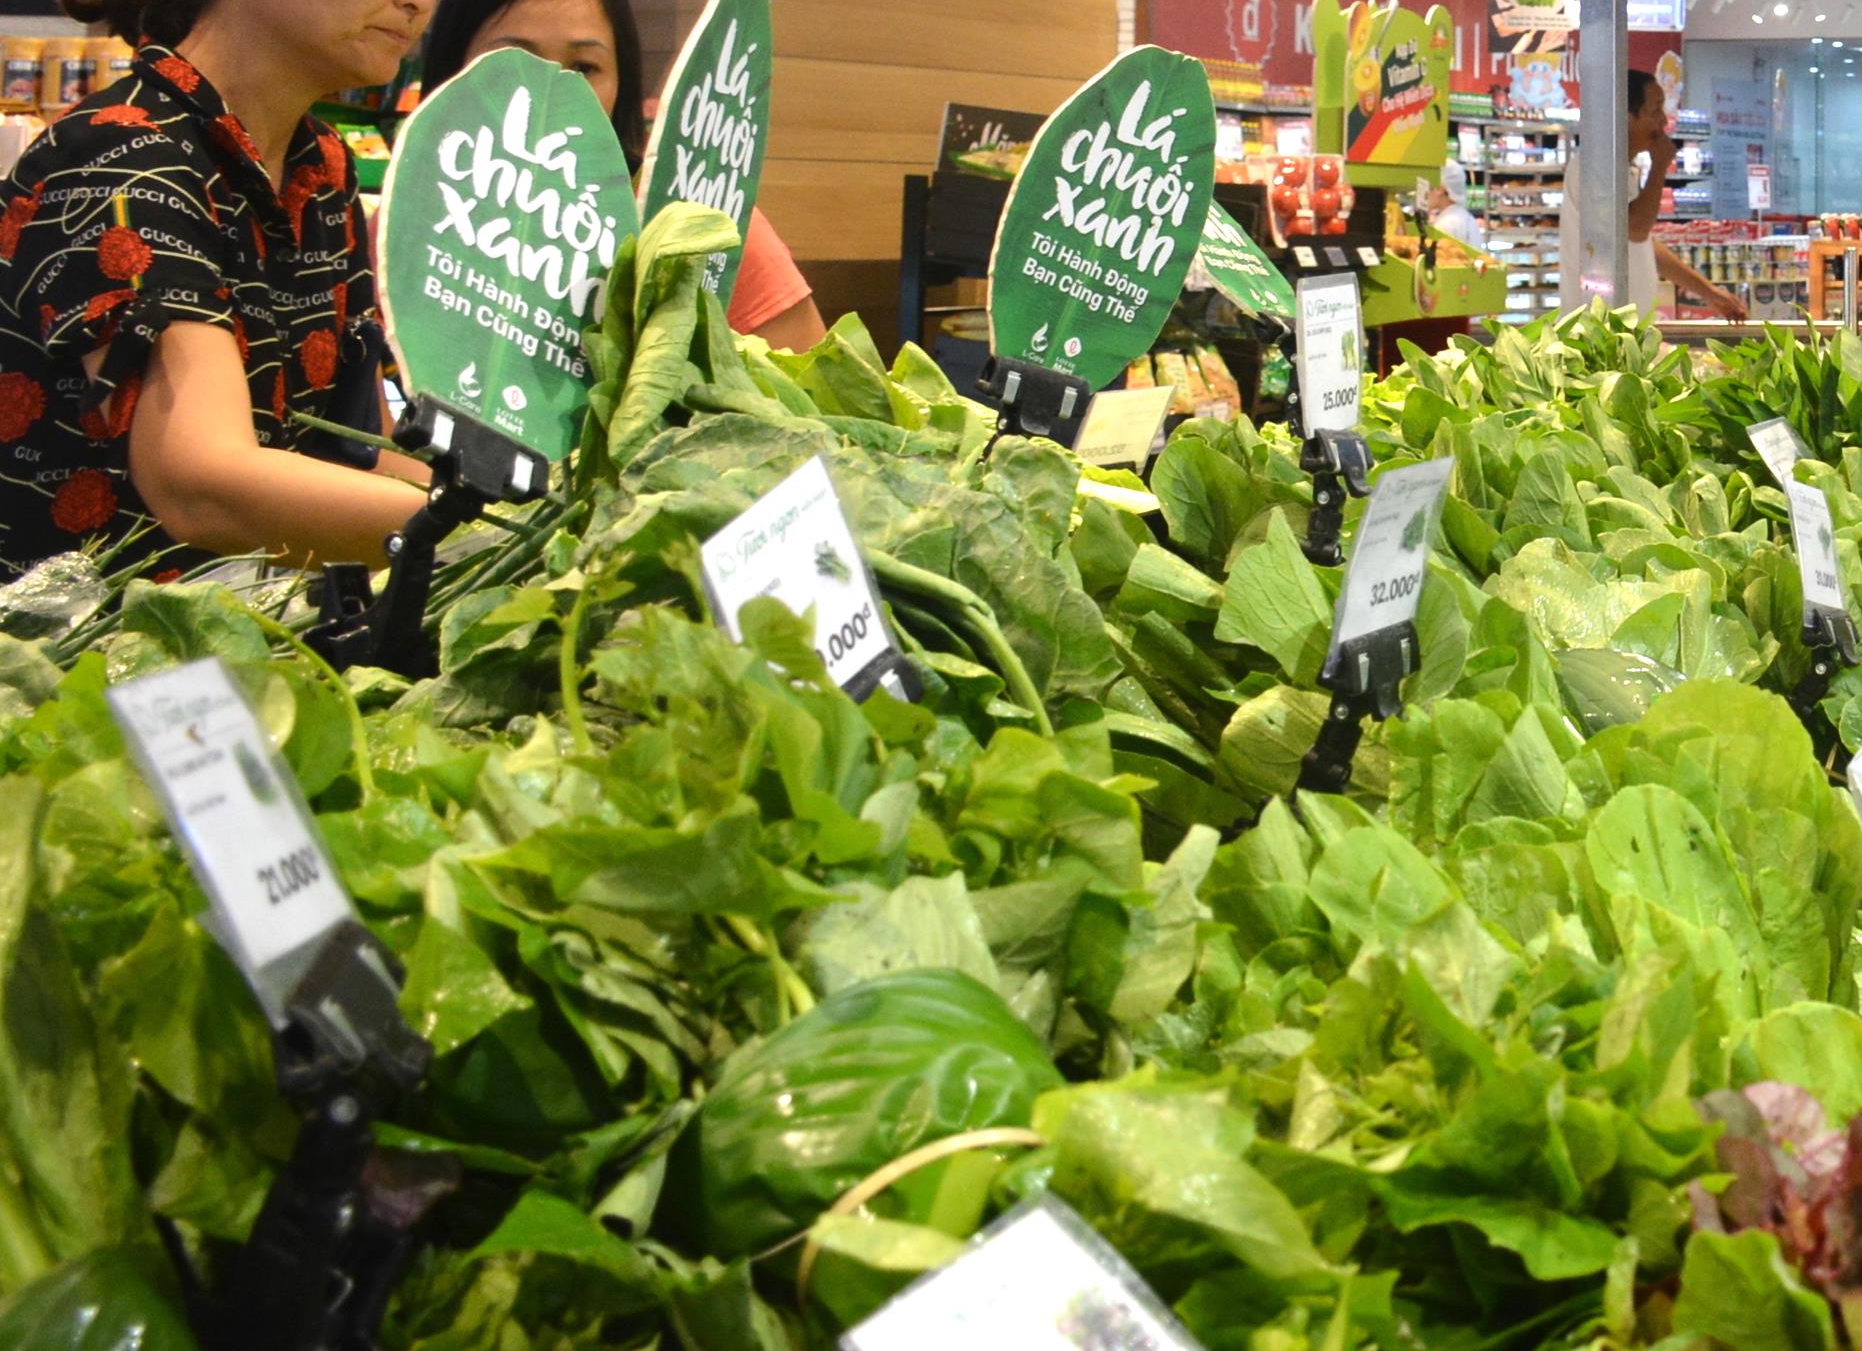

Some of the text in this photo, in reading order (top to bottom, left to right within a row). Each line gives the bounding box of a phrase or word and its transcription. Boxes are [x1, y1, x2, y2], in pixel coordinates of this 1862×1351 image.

[715, 18, 758, 108] Lá
[81, 144, 129, 177] GUCCI
[503, 86, 583, 190] Lá
[680, 72, 758, 177] chuối
[1116, 80, 1188, 163] Lá
[438, 125, 617, 270] chuối
[1060, 120, 1196, 229] chuối
[138, 226, 193, 255] GUCCI
[432, 181, 606, 325] xanh
[1032, 231, 1150, 308] Tôi Hành Động
[1041, 176, 1176, 277] xanh
[158, 289, 201, 304] UCCI
[423, 275, 471, 319] Bạn
[475, 304, 540, 358] Cũng
[427, 245, 588, 357] Tôi Hành Độn
[1022, 256, 1140, 324] Bạn Cũng Thế
[494, 414, 524, 437] Mart
